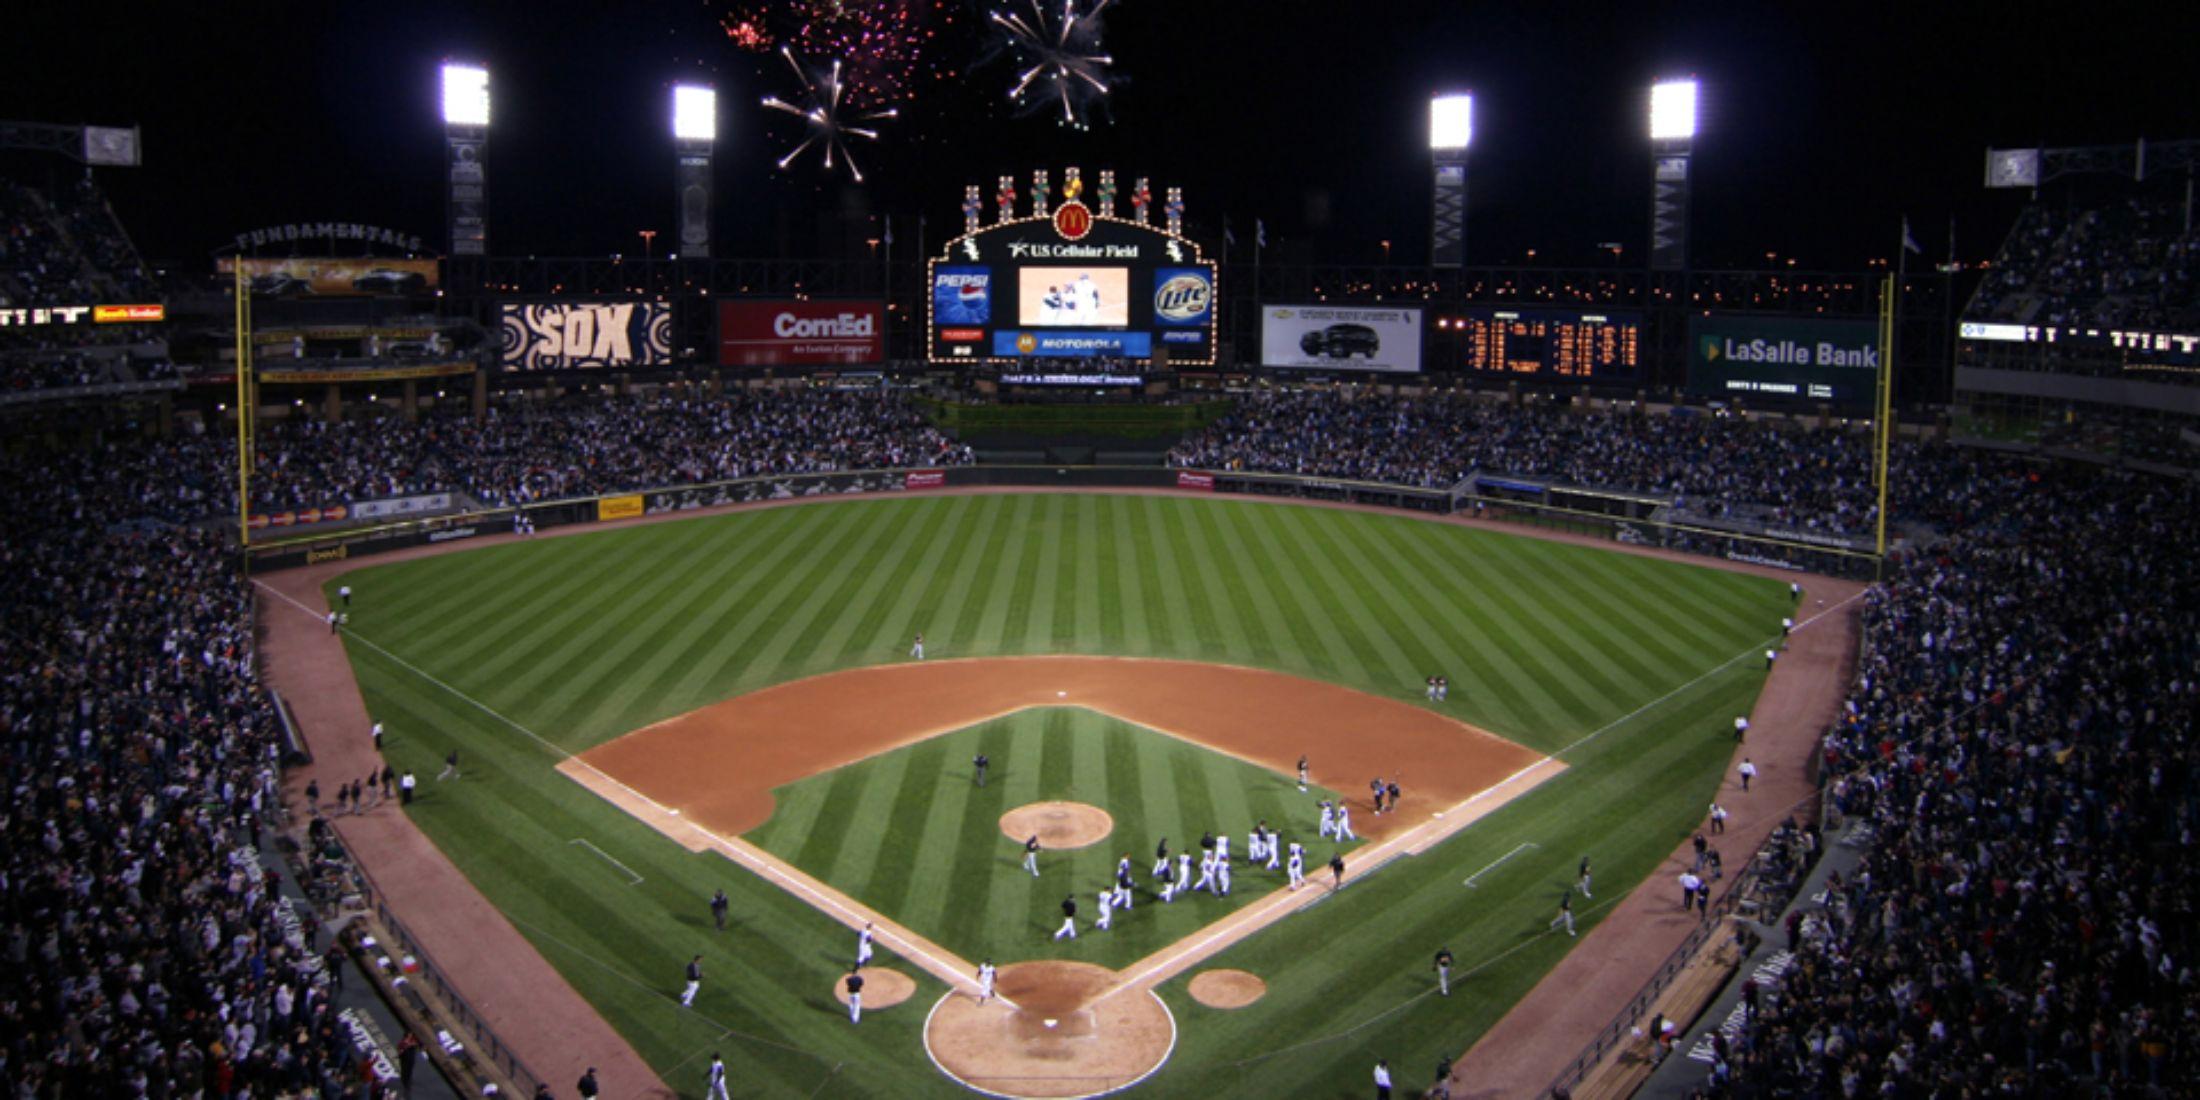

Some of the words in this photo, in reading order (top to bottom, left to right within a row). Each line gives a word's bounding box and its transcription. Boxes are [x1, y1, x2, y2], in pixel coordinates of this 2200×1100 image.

[235, 222, 424, 251] FUNDAMENTALS
[1052, 244, 1103, 258] Cellular
[1105, 245, 1139, 258] Field
[935, 273, 989, 288] PEPSI
[1161, 285, 1207, 311] Lite
[537, 302, 637, 362] SOX
[773, 312, 873, 339] ComEd
[792, 344, 805, 354] An
[834, 344, 873, 355] Company
[1041, 338, 1122, 350] MOTOROLA
[1724, 337, 1810, 365] LaSalle
[1815, 342, 1878, 369] Bank
